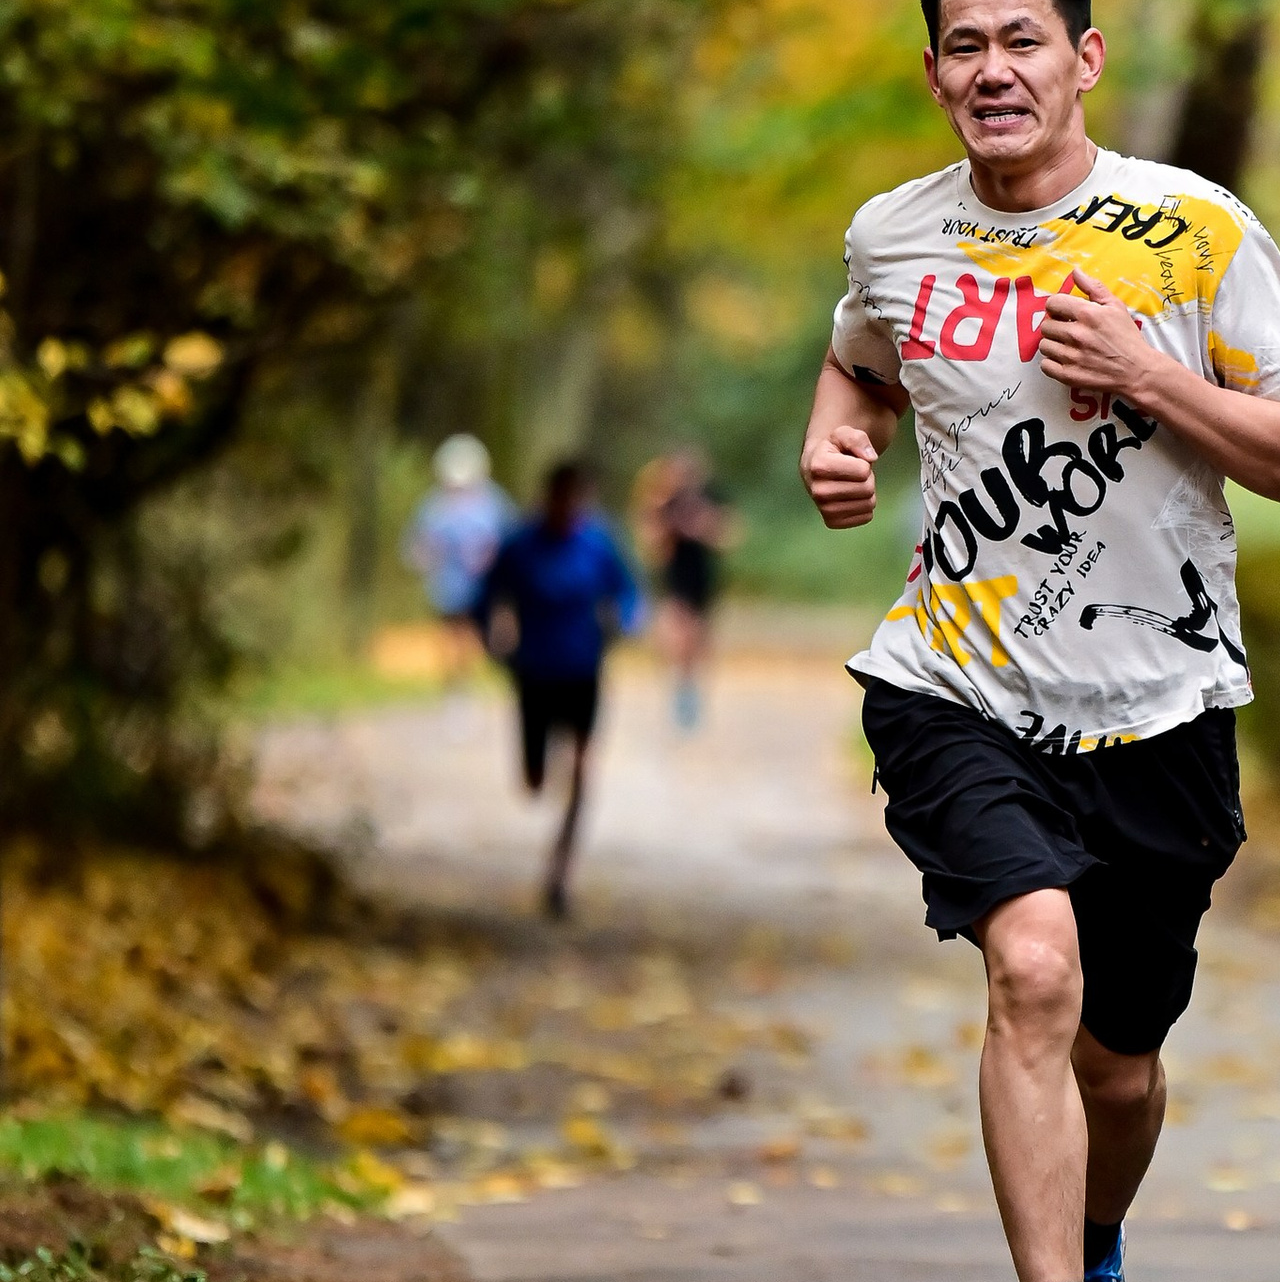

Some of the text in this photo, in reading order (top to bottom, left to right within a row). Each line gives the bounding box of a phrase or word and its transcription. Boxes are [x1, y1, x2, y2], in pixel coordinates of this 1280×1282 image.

[941, 218, 1038, 250] TRUST YOUR
[1020, 399, 1159, 555] WORL
[1014, 528, 1087, 640] TRUST YOUR
[1033, 541, 1107, 637] CRAZY IDEA
